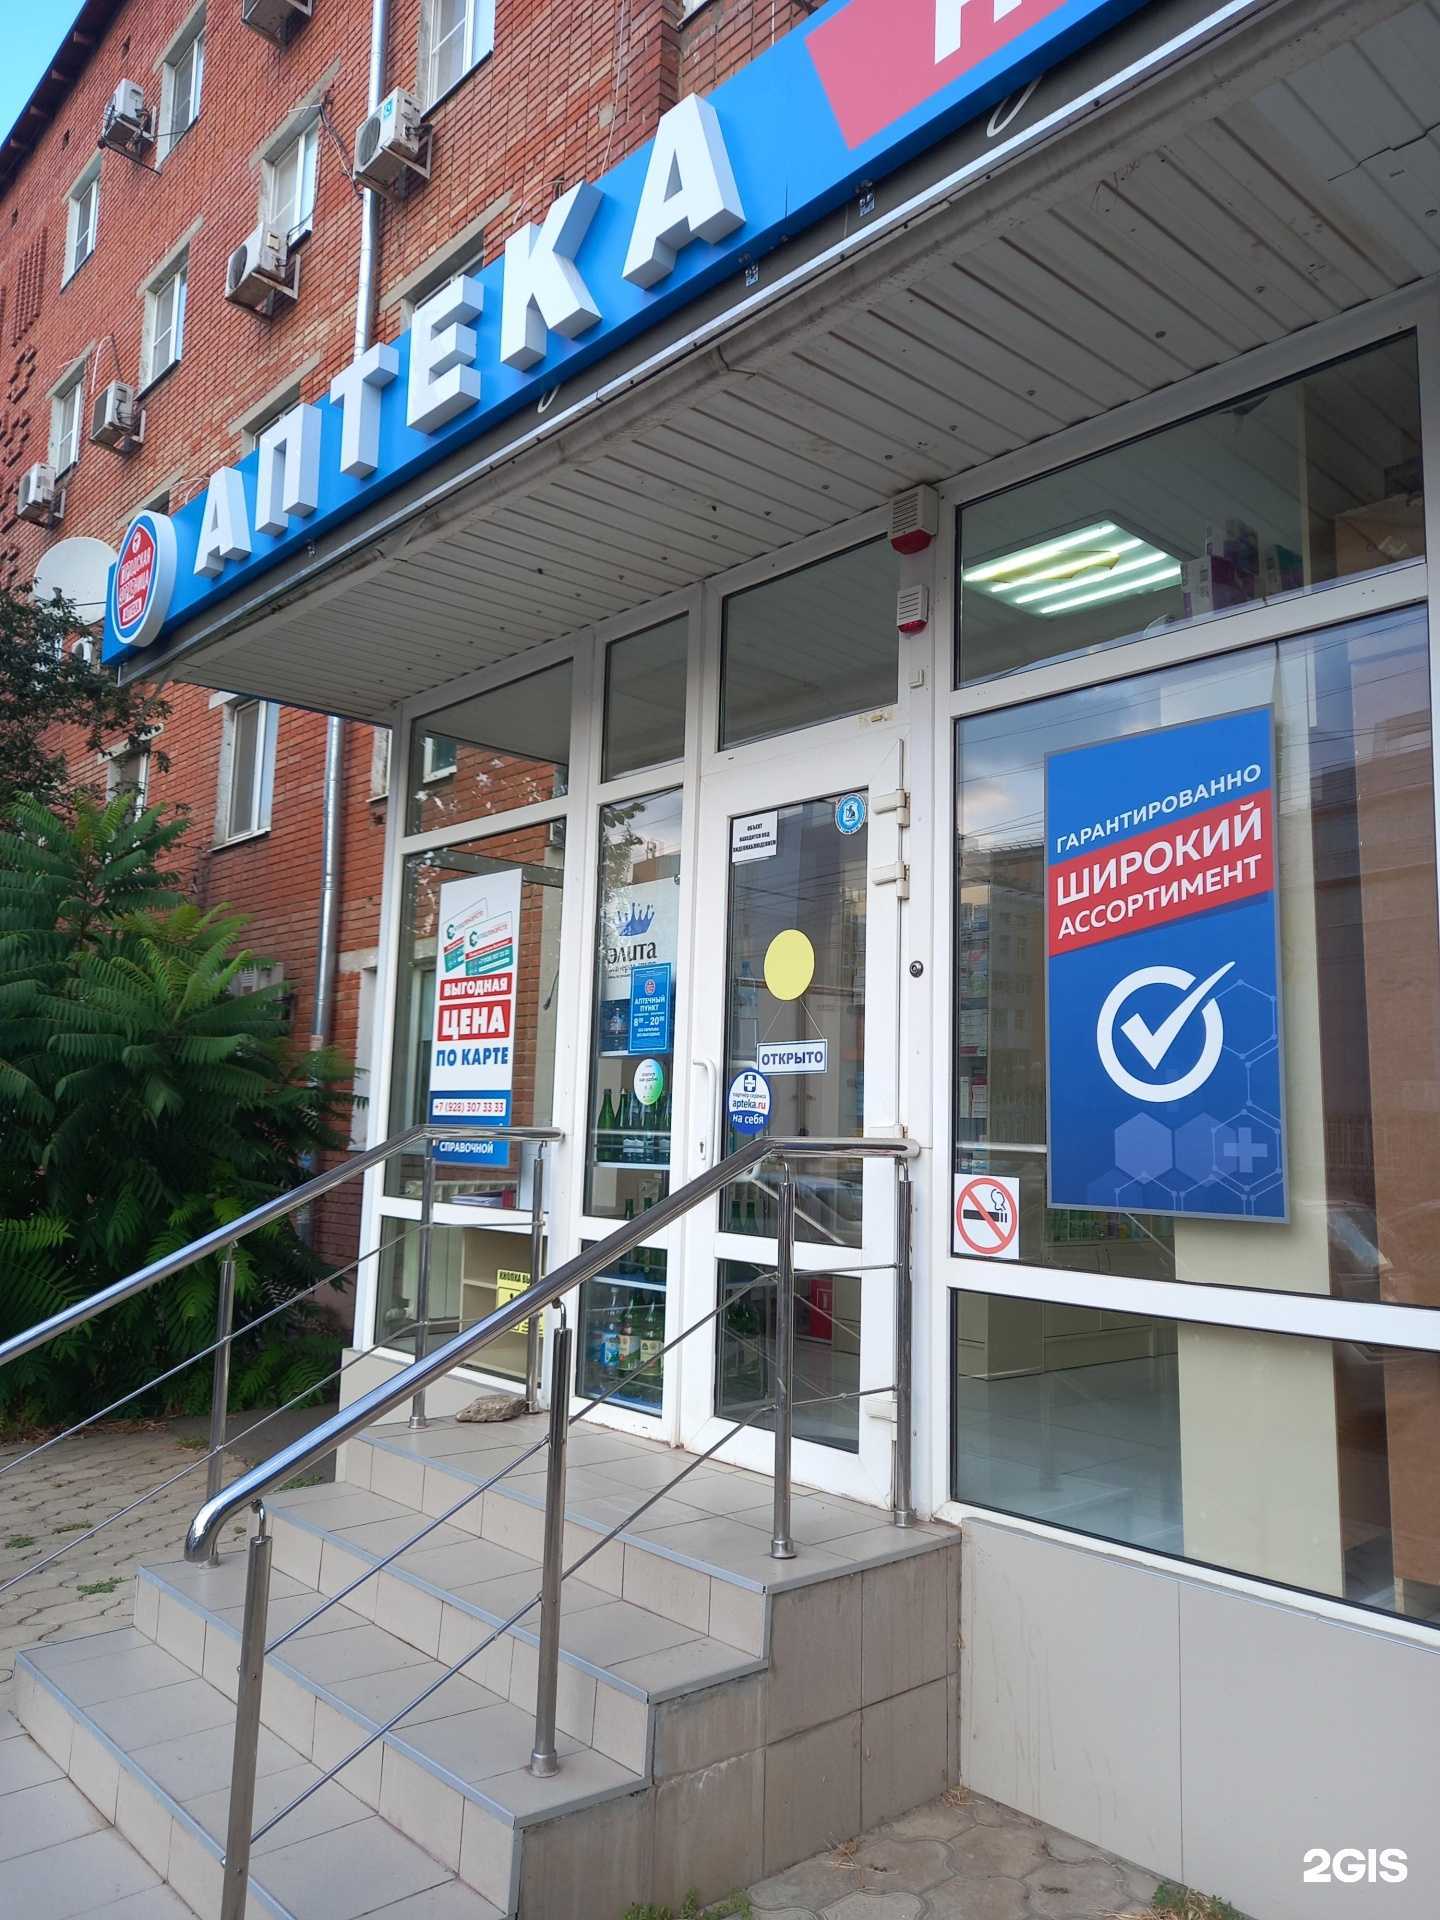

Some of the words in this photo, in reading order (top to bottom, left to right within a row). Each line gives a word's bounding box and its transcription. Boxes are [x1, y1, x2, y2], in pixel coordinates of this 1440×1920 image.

[193, 92, 747, 580] АПТЕКА
[1056, 764, 1262, 854] ГАРАНТИРОВАННО
[1056, 801, 1262, 907] ШИРОКИЙ
[1057, 853, 1262, 940] АССОРТИМЕНТ
[443, 977, 508, 997] ВЫГОДНАЯ
[634, 994, 666, 1005] АПТЕЧНЫЙ
[639, 1003, 660, 1012] ПУНКТ
[441, 1005, 506, 1040] ЦЕНА
[436, 1049, 457, 1066] ПО
[461, 1046, 509, 1066] КАРТЕ
[761, 1051, 823, 1066] ОТКРЫТО
[732, 1099, 766, 1110] apteka.ru
[732, 1113, 743, 1123] на
[744, 1114, 764, 1125] себя
[439, 1140, 494, 1154] СПРАВОЧНОЙ
